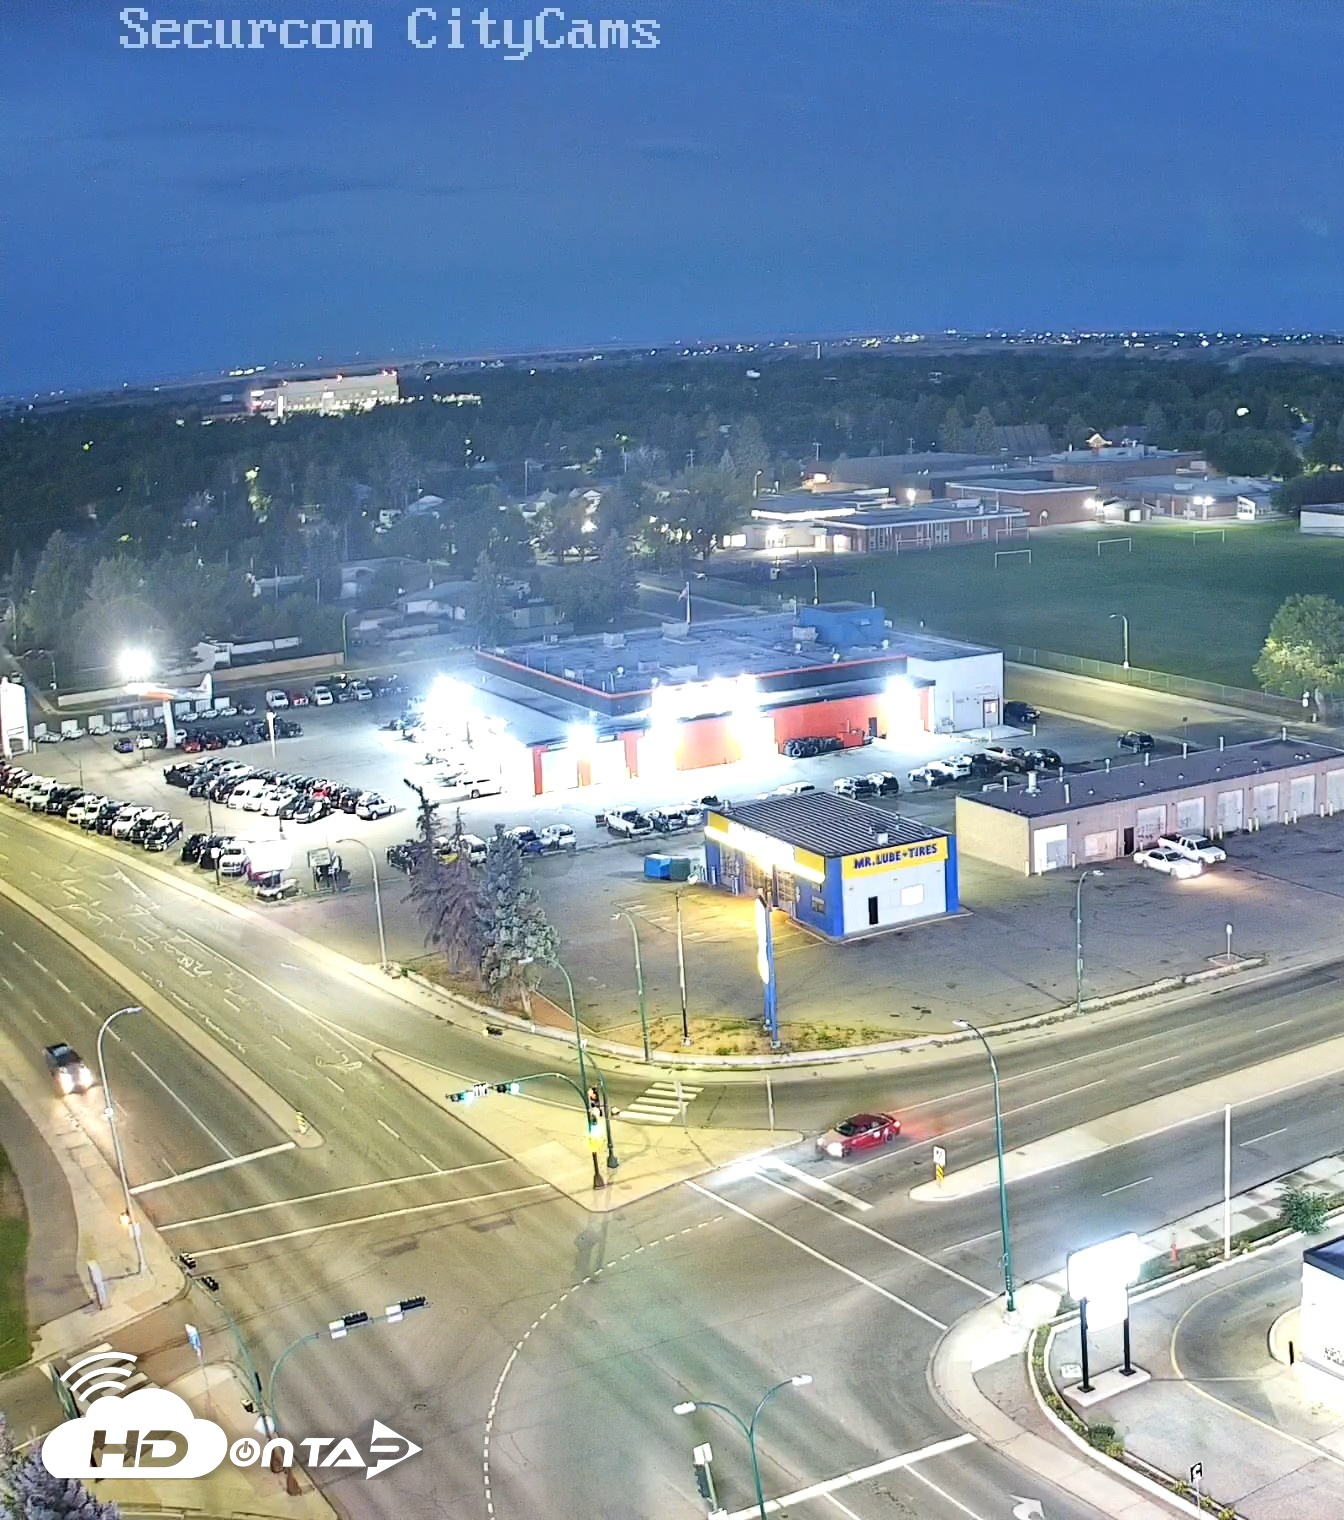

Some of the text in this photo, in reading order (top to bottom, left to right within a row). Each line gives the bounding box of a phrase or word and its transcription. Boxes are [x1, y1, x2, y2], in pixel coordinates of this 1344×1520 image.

[854, 857, 875, 869] MR.
[876, 850, 901, 864] LUBE
[908, 844, 937, 858] TIRES
